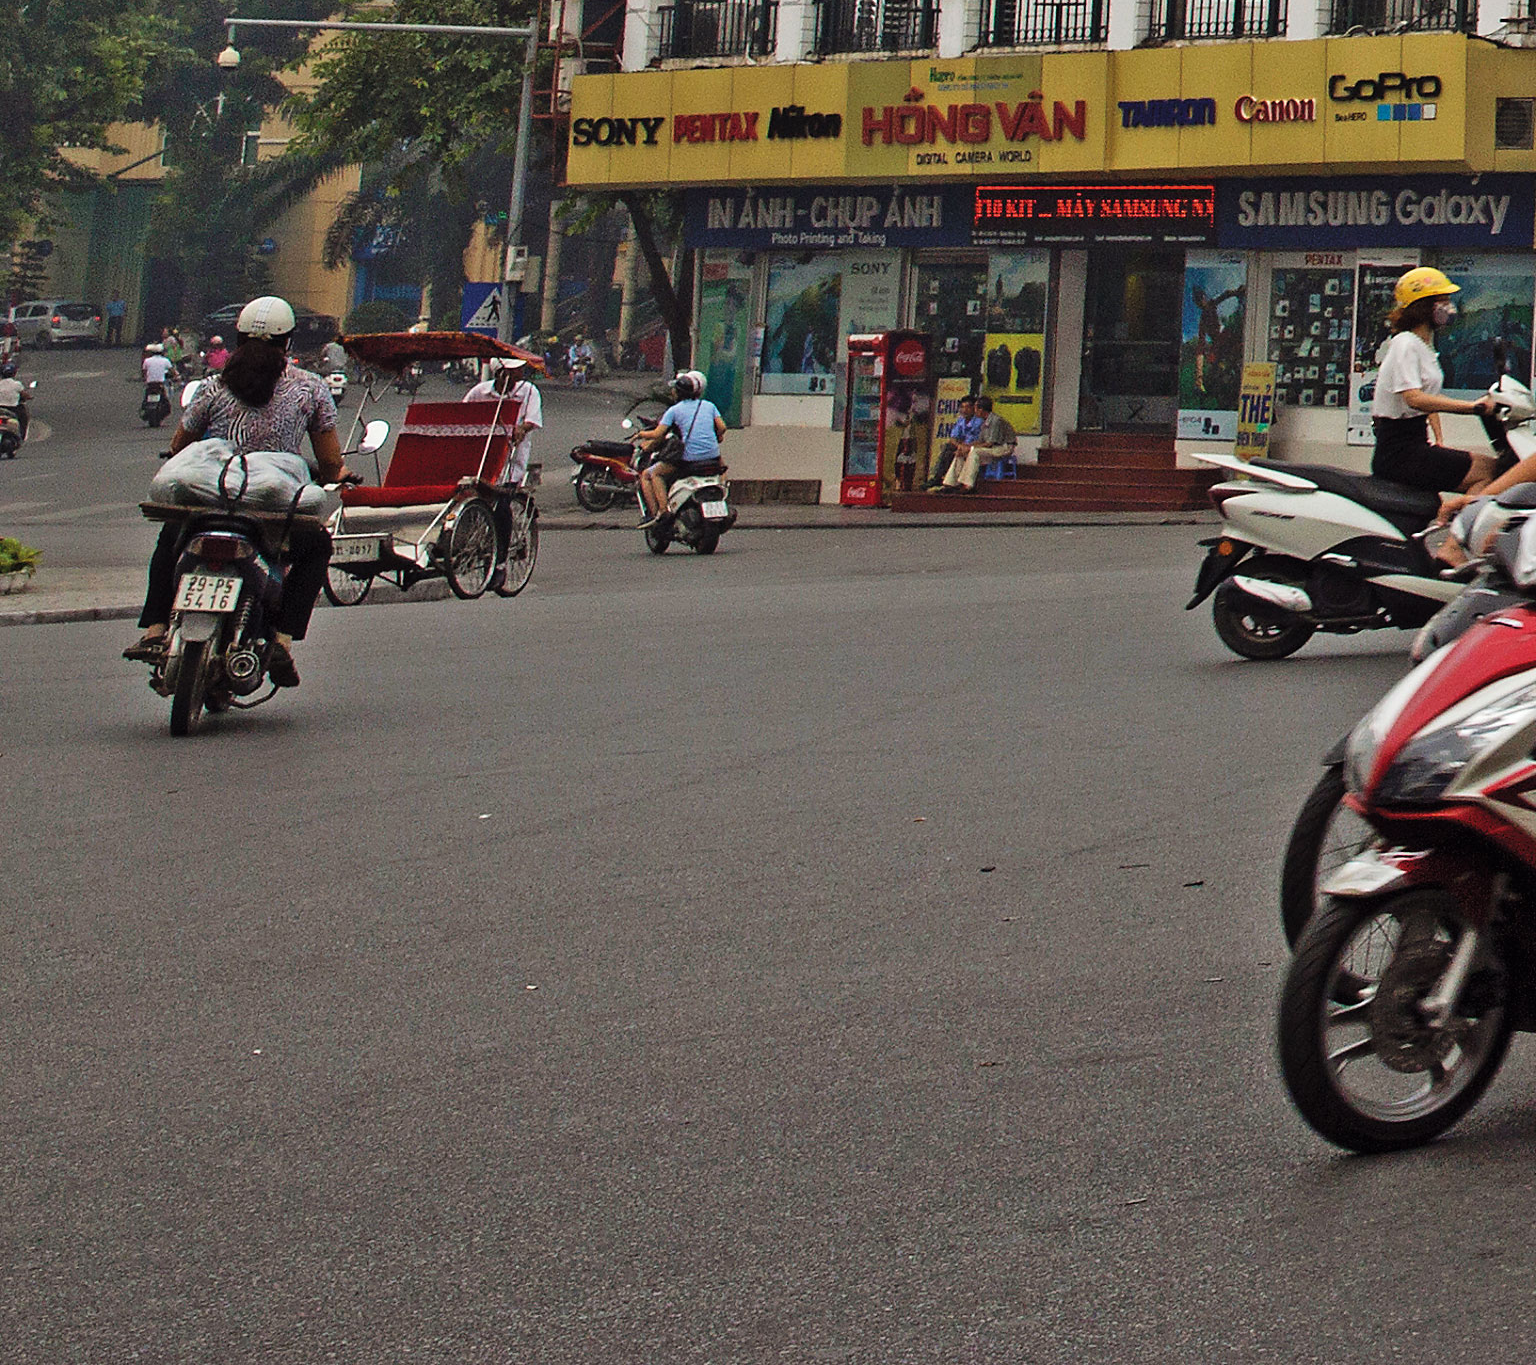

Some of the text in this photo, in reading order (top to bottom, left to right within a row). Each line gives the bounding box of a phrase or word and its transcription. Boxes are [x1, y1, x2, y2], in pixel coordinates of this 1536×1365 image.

[572, 71, 1443, 148] SONY PENTAX Nikon HỒNG VÂN TAMRON Canon GoPro
[916, 150, 1032, 165] DIGITAL CAMERA WORLD
[707, 196, 735, 230] IN
[1005, 199, 1037, 218] KIT
[1100, 199, 1188, 218] SAMSUNG
[1237, 187, 1511, 235] SAMSUNG Galaxy
[771, 231, 887, 247] Photo Printing and Taking
[851, 262, 892, 275] SONY
[1304, 252, 1344, 267] PENTAX
[187, 576, 235, 594] 29-P5
[183, 591, 230, 610] 5416
